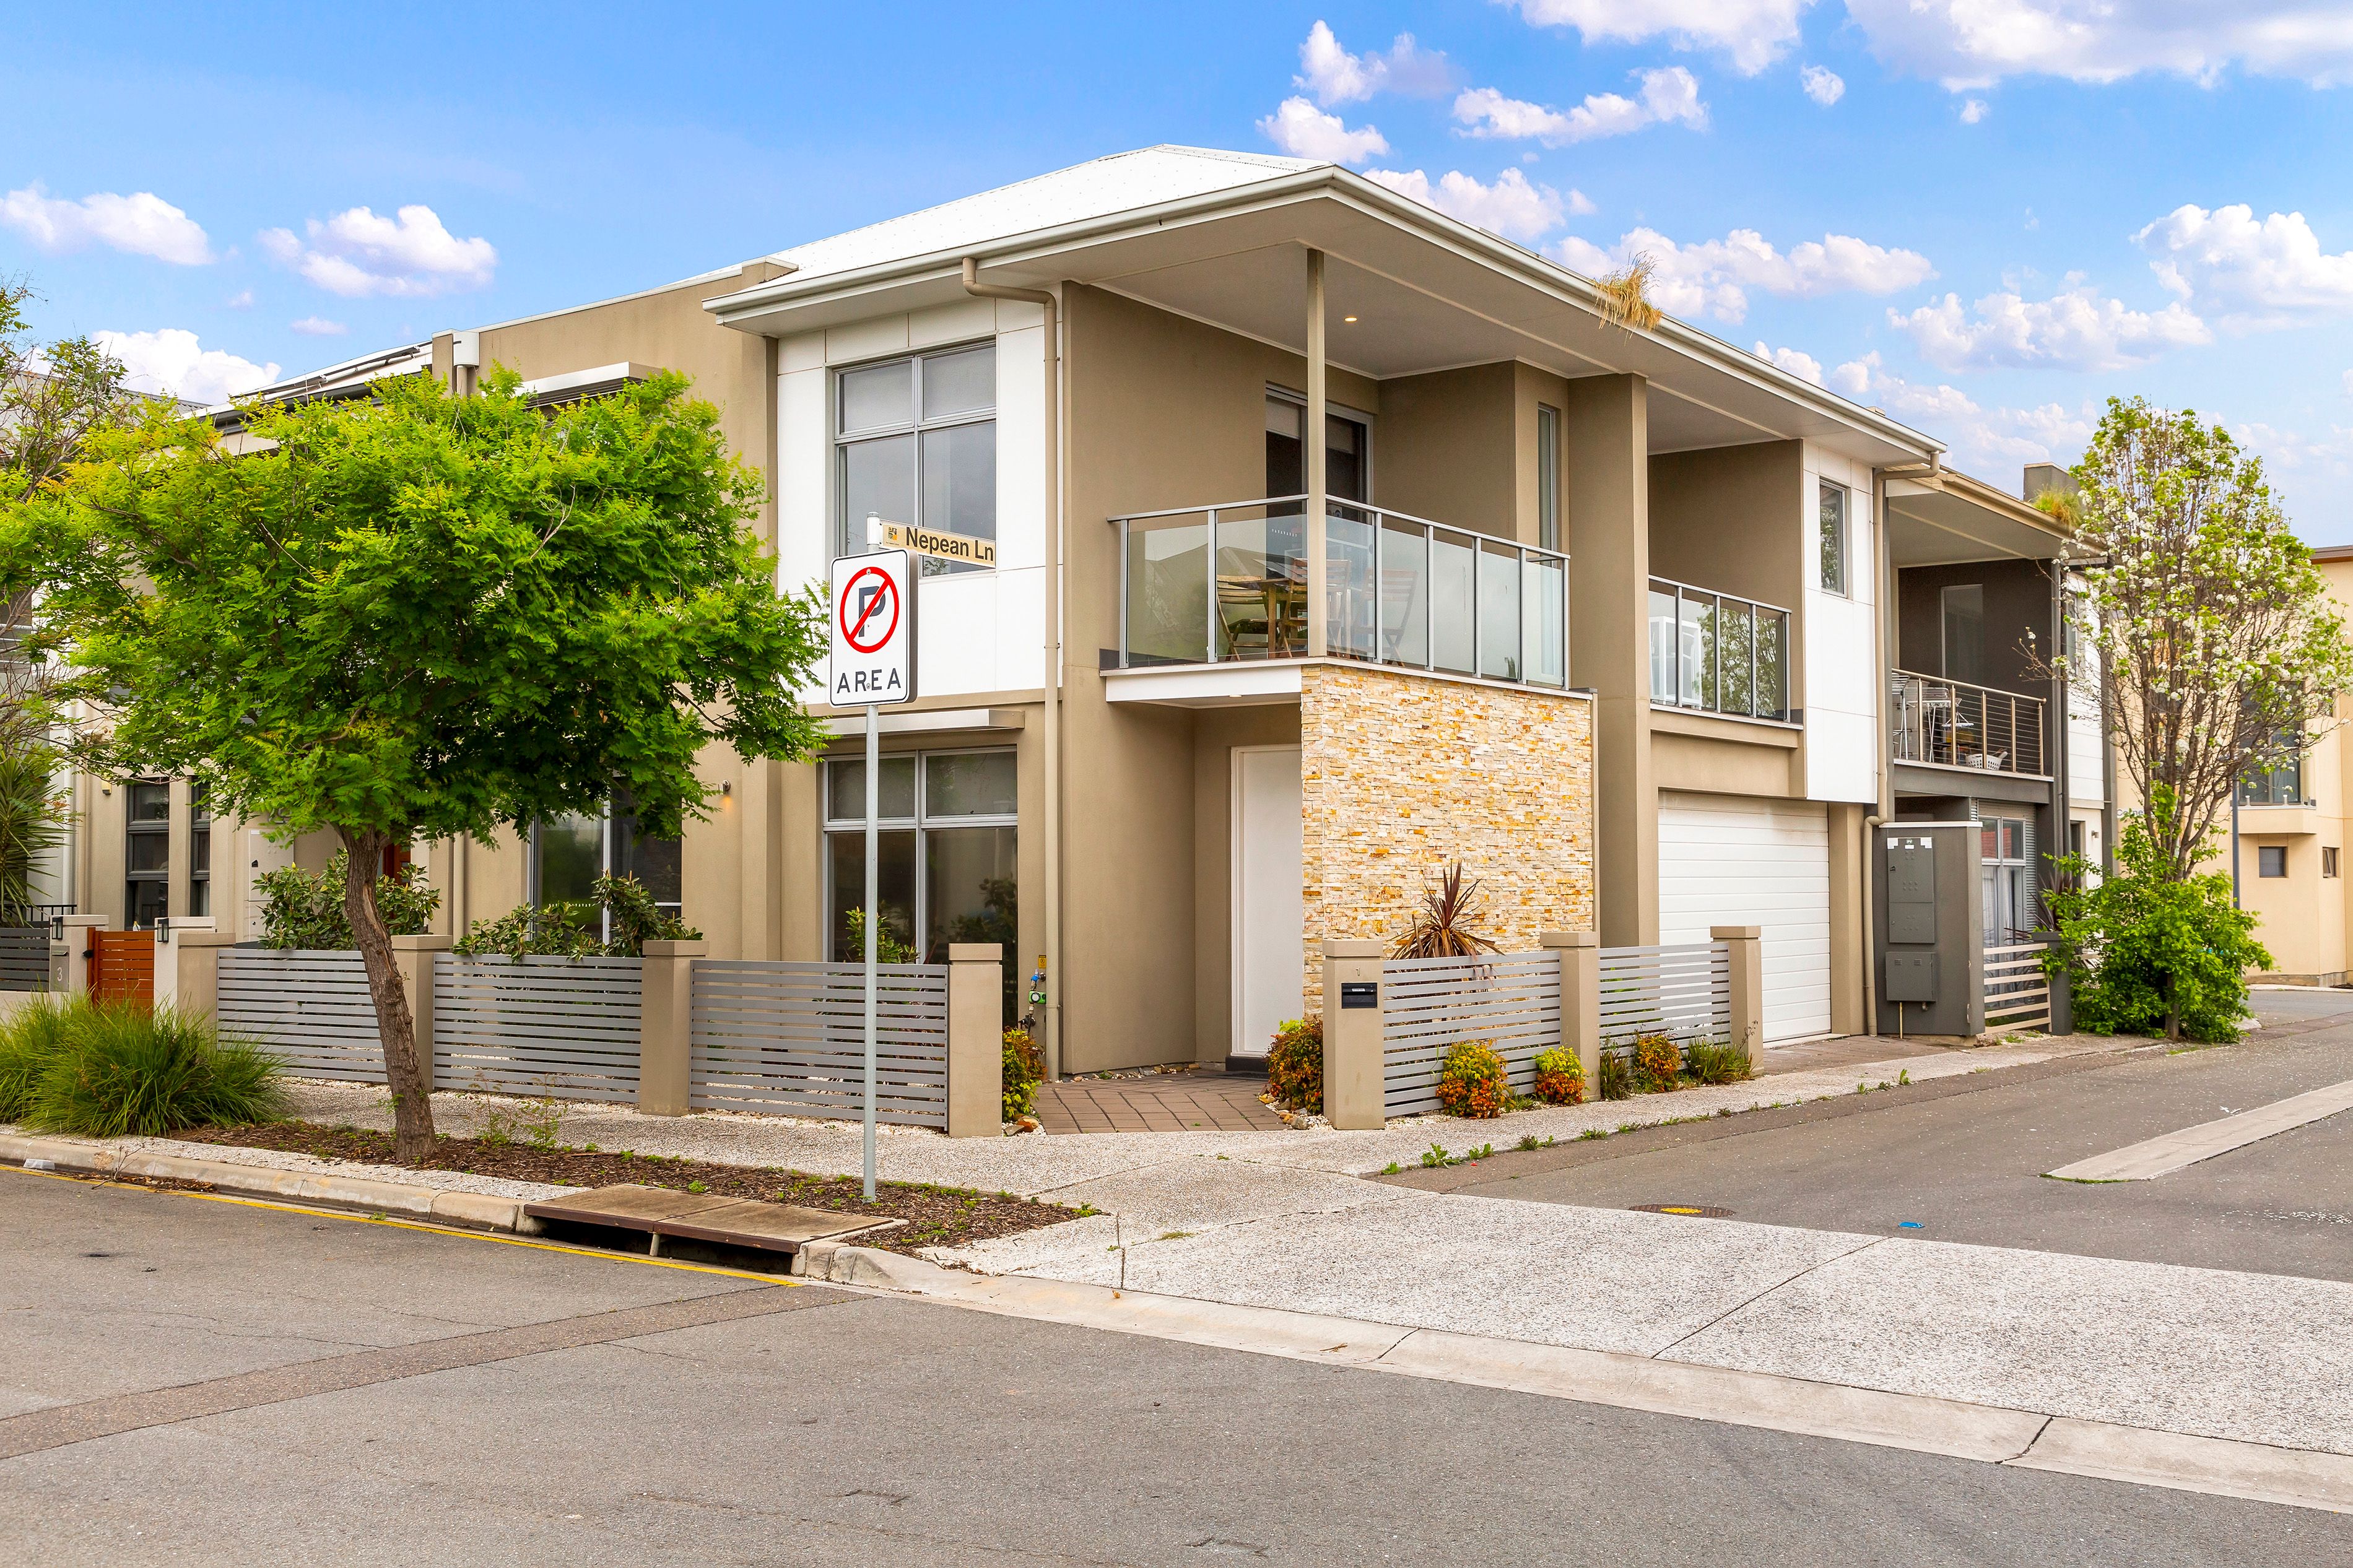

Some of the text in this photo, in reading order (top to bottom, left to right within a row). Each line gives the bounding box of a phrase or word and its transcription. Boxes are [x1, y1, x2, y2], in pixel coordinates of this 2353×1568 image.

[906, 527, 994, 561] Nepean Ln
[858, 586, 886, 637] P
[837, 668, 902, 694] AREA
[57, 966, 63, 981] 3
[1355, 966, 1360, 976] 1
